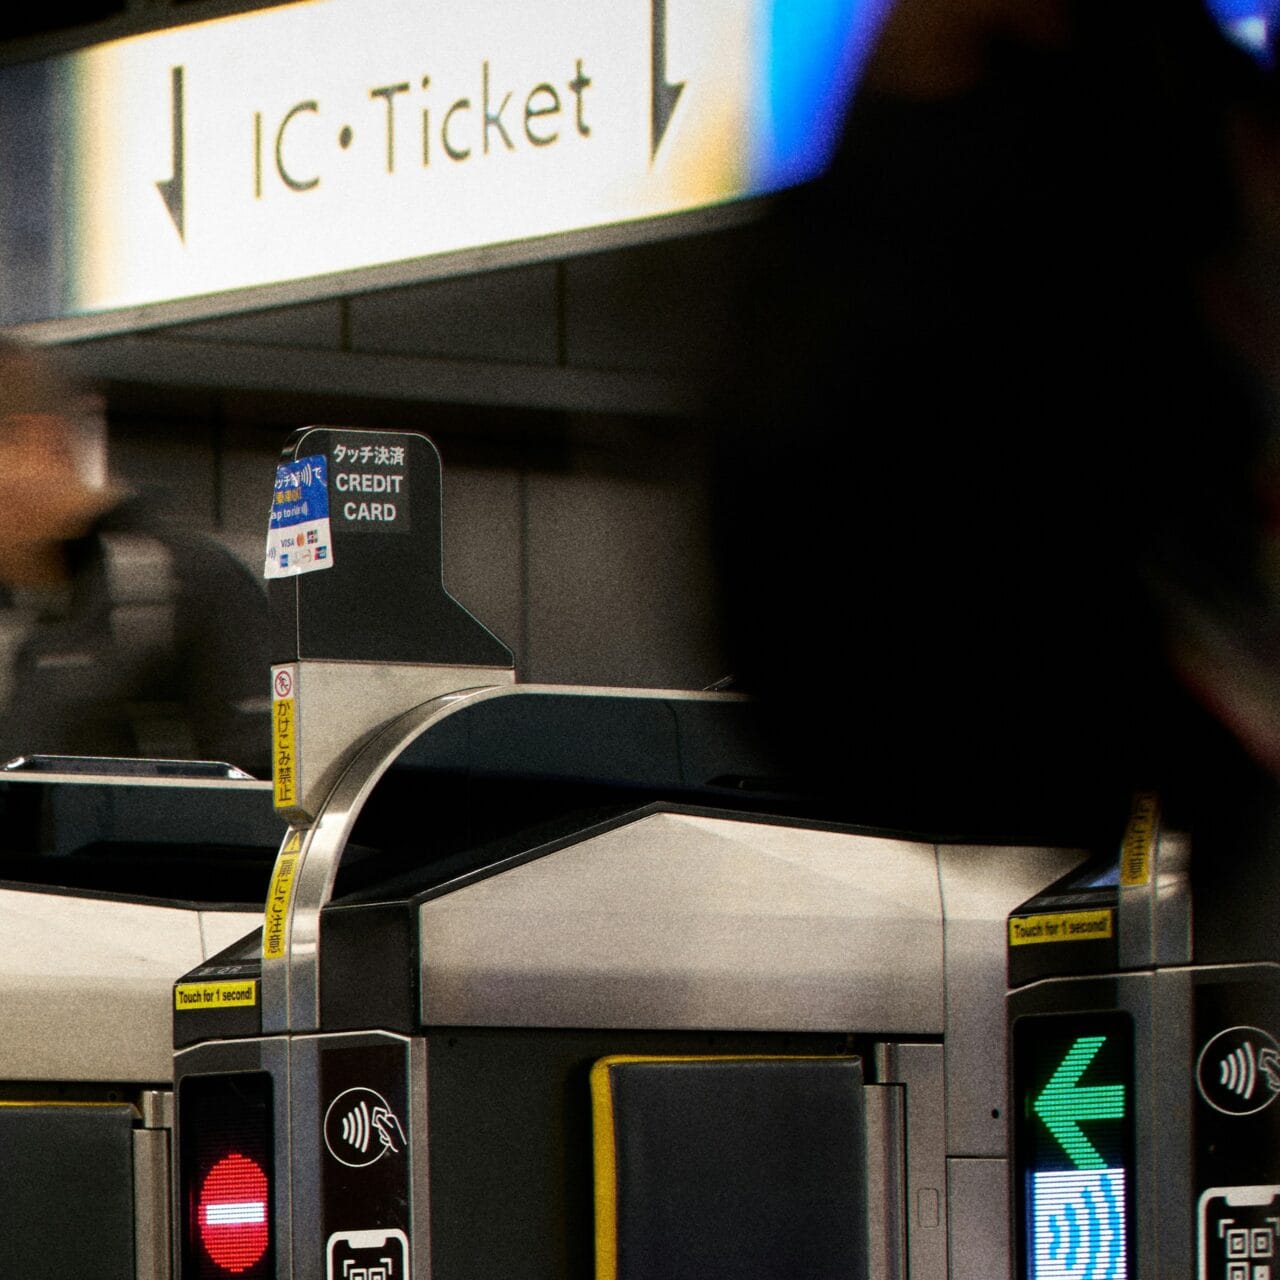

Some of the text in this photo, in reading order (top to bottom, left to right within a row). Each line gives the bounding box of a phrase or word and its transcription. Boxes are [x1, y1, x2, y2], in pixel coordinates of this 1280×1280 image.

[334, 444, 405, 466] タッチ決済
[336, 473, 404, 494] CREDIT
[343, 502, 397, 522] CARD
[276, 701, 293, 802] かけこみ禁止
[268, 858, 294, 954] 扉にご注意
[179, 990, 202, 1004] Touch
[203, 990, 214, 1003] for
[222, 987, 252, 1002] second!
